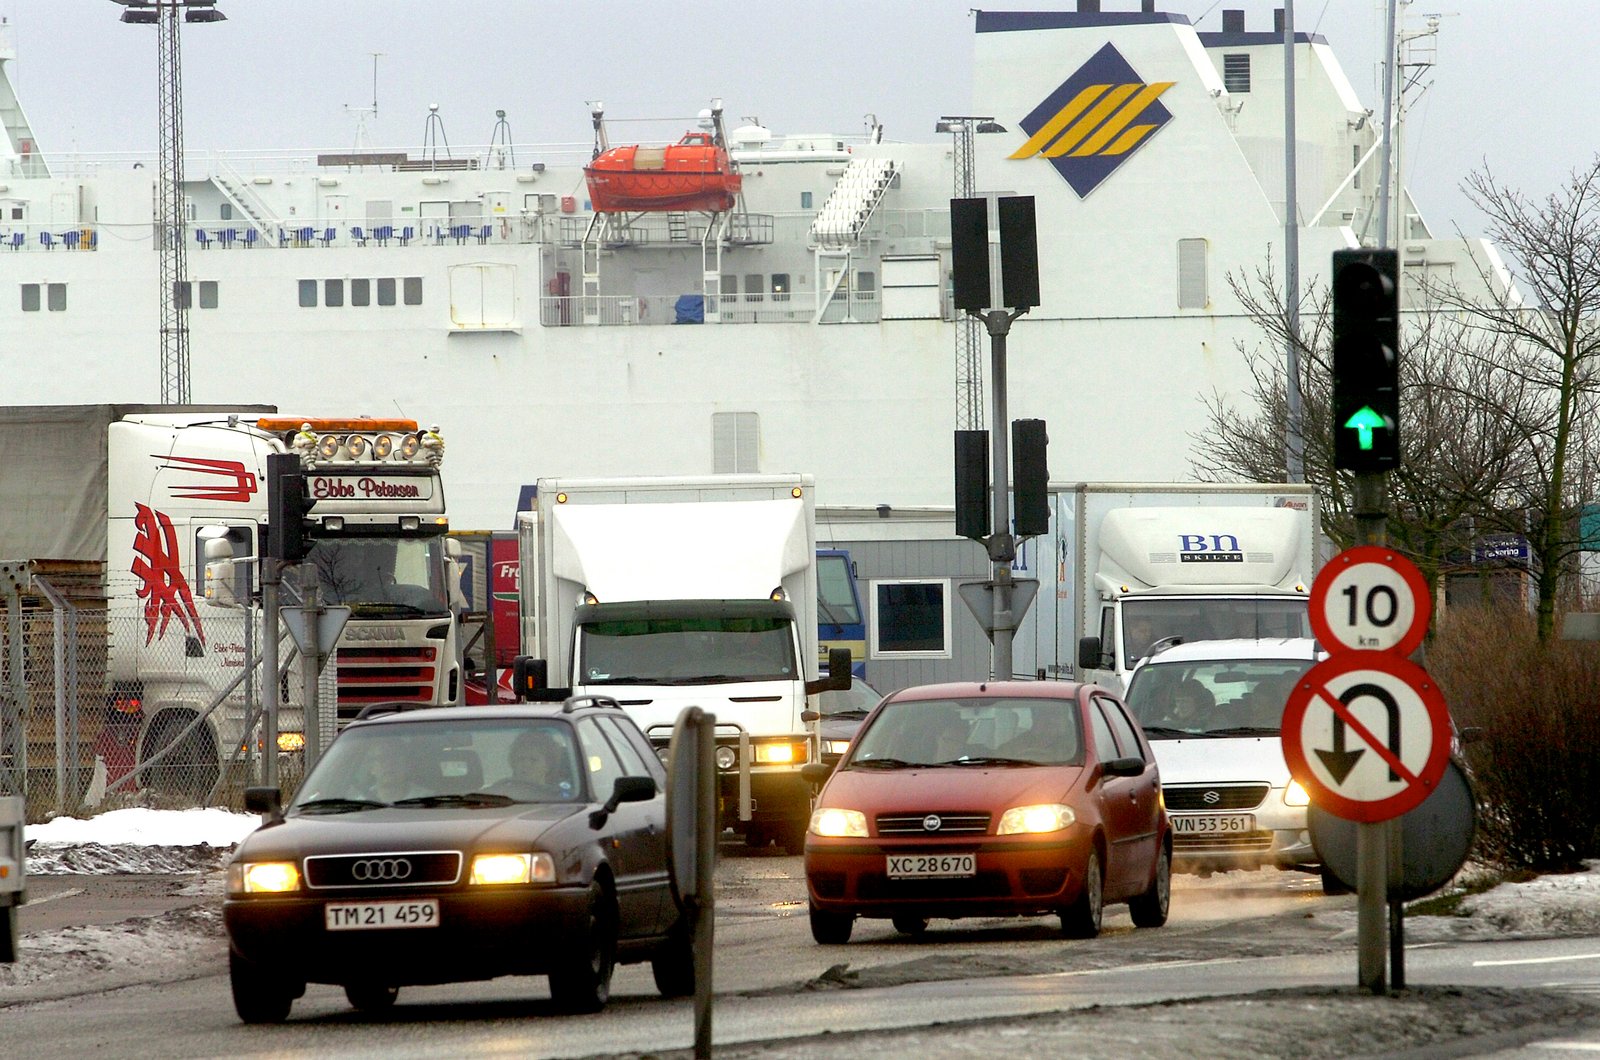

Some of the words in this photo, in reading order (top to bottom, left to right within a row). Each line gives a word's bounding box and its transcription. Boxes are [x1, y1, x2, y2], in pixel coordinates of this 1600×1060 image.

[313, 477, 355, 498] Ebbe
[357, 477, 419, 498] Petersen
[1177, 534, 1242, 552] Bn
[1342, 584, 1399, 628] 10
[345, 626, 406, 641] SCANIA
[1359, 635, 1380, 647] km
[1174, 819, 1196, 832] VN
[1199, 818, 1217, 832] 53
[1220, 817, 1245, 831] 561
[890, 858, 913, 873] XC
[917, 857, 938, 872] 28
[941, 856, 973, 872] 670
[330, 908, 359, 925] TM
[364, 907, 385, 924] 21
[395, 904, 434, 923] 459
